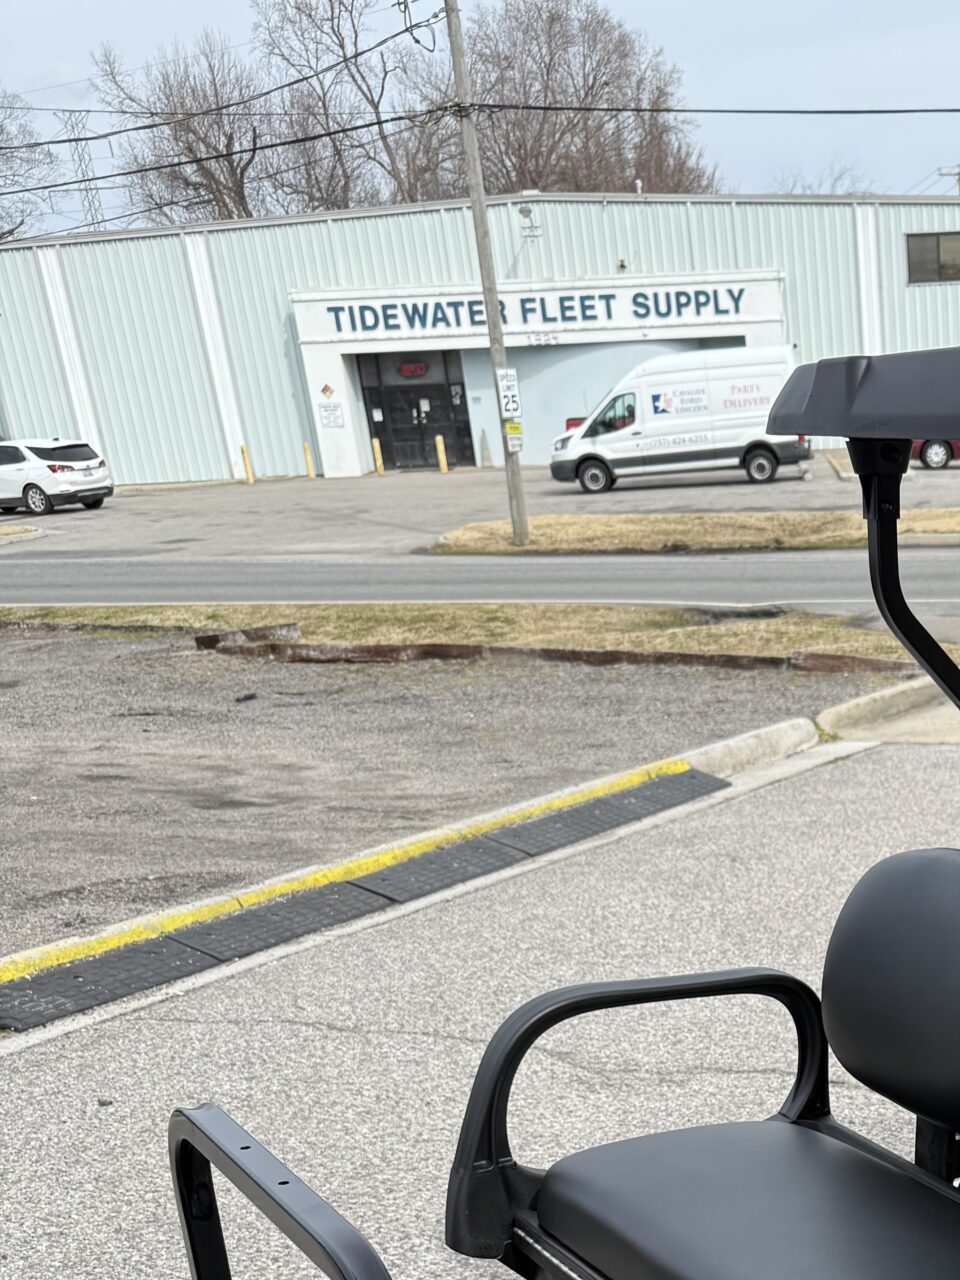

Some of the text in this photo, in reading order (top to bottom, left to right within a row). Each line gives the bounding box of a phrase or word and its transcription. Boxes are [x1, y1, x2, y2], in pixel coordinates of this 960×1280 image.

[520, 294, 616, 324] FLEET
[632, 288, 745, 318] SUPPLY
[503, 394, 520, 413] 25
